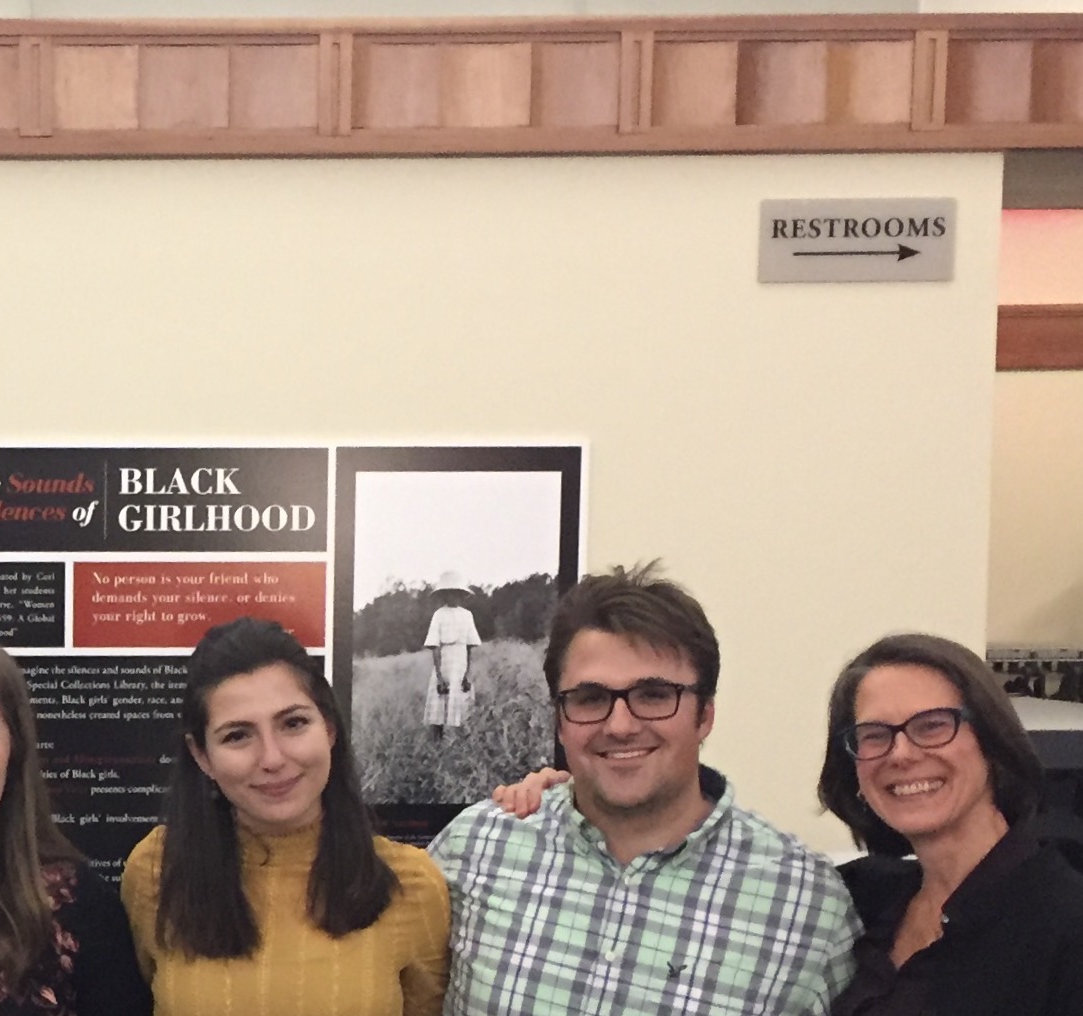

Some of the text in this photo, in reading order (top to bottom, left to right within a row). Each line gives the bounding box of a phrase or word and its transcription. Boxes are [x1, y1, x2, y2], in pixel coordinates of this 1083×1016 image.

[772, 217, 946, 239] RESTROOMS
[9, 472, 95, 493] Sounds
[119, 468, 241, 495] BLACK
[72, 501, 99, 528] of
[118, 504, 316, 532] GIRLHOOD
[22, 572, 32, 582] by
[93, 572, 279, 587] No person is your friend who
[4, 586, 17, 595] her
[92, 592, 147, 603] demands
[151, 594, 181, 606] your
[236, 594, 249, 603] or
[254, 592, 295, 603] denies
[92, 613, 121, 625] your
[126, 610, 156, 625] right
[161, 611, 174, 622] to
[164, 665, 188, 674] Black
[62, 695, 85, 704] Black
[72, 769, 96, 779] Black
